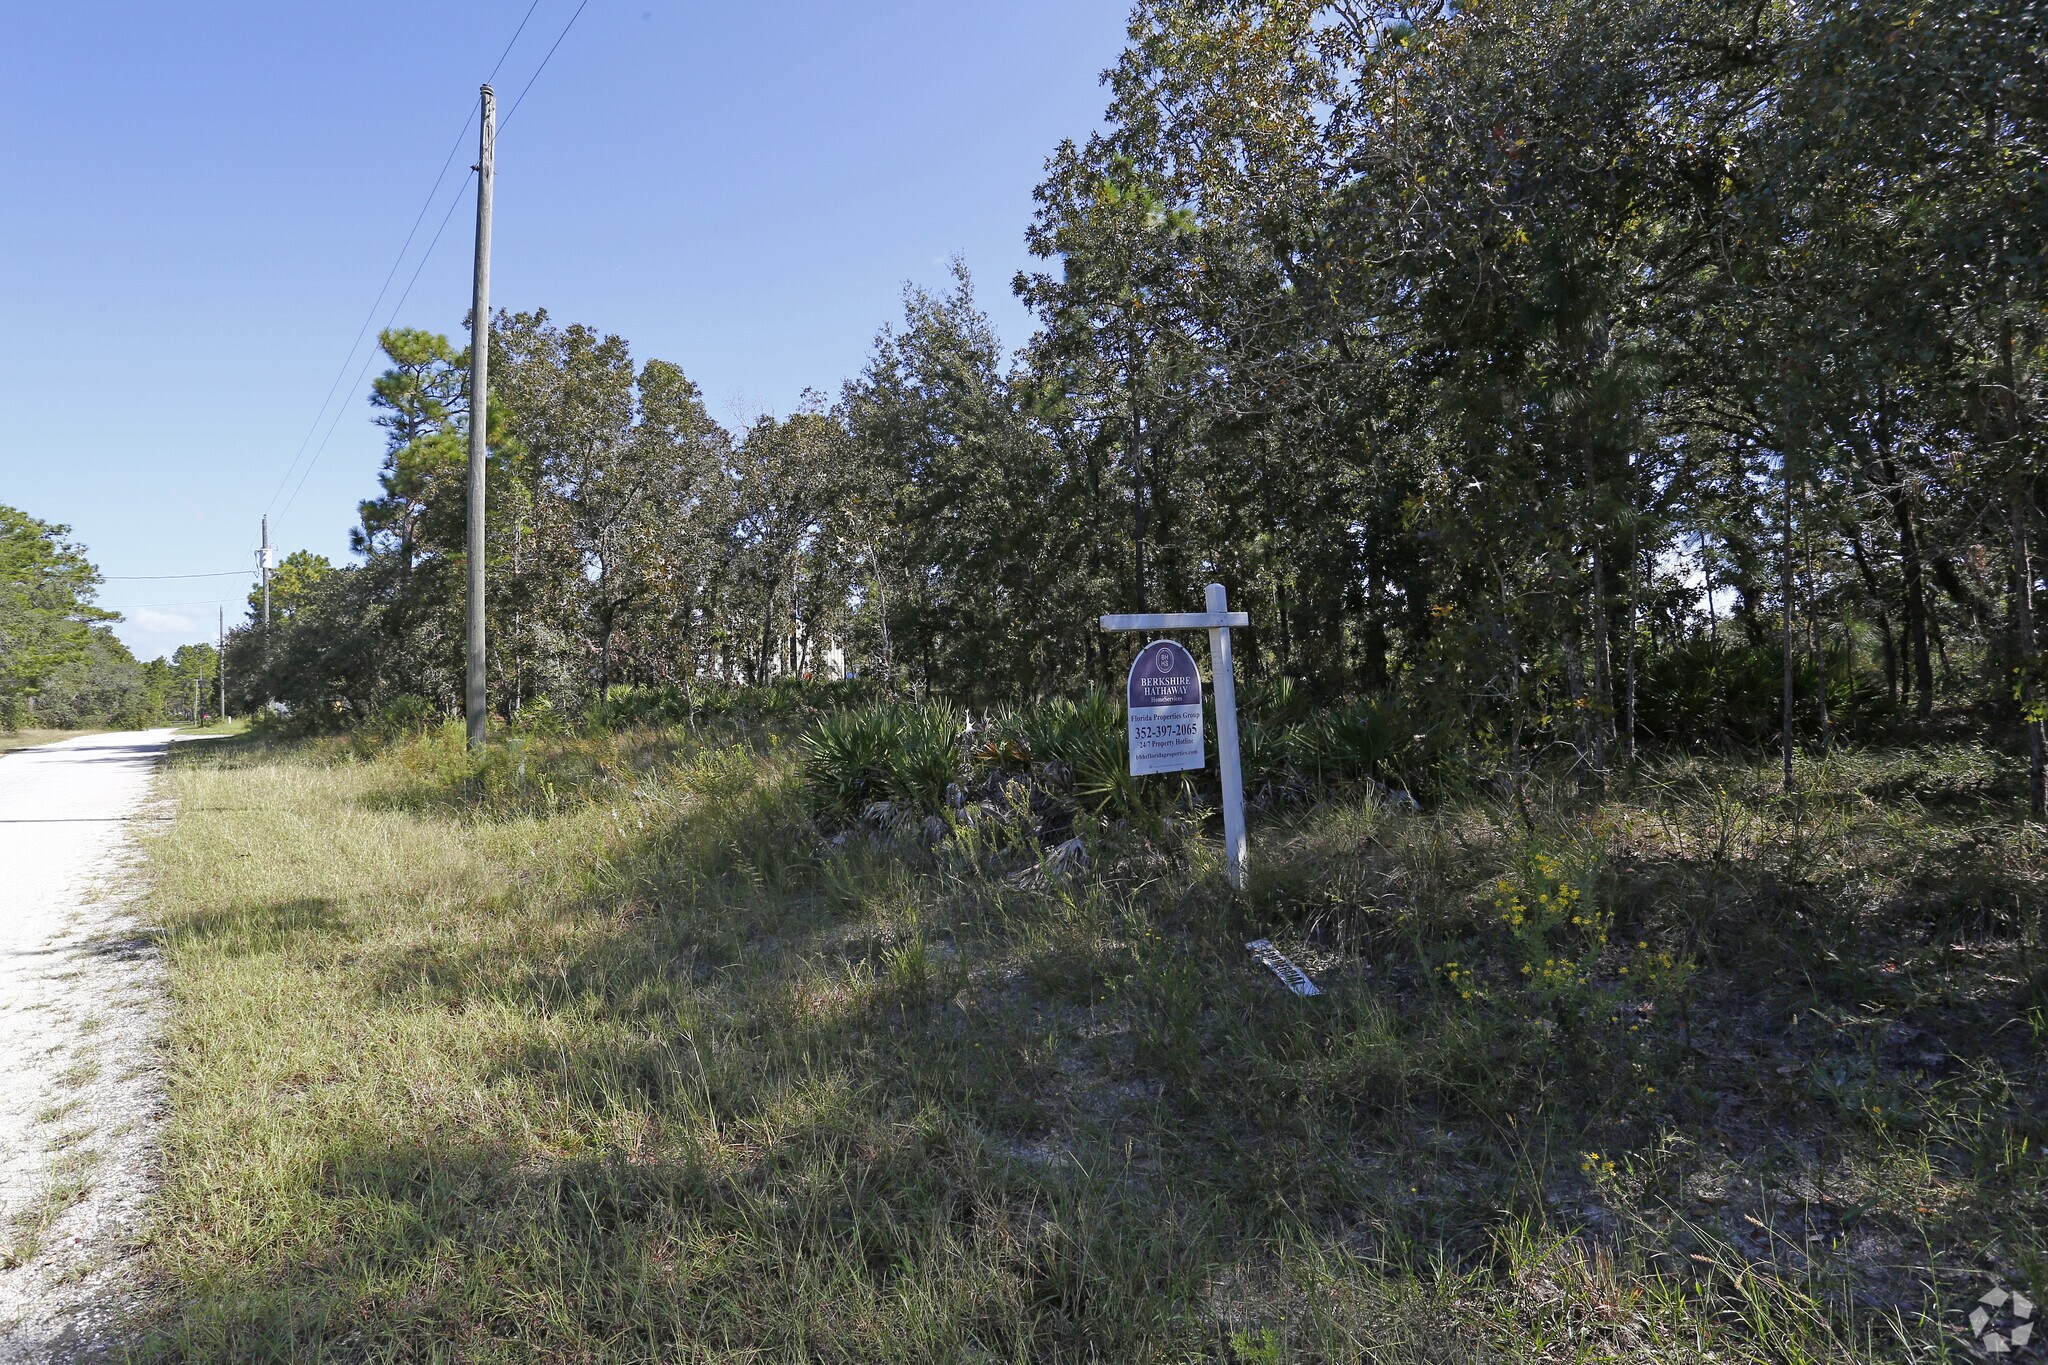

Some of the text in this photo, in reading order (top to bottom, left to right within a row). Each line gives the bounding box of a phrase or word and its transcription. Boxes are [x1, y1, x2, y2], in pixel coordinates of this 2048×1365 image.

[1141, 677, 1191, 686] BERKSHIRE
[1144, 686, 1188, 696] HATHAWAY
[1131, 712, 1200, 722] Florida Properties Group
[1135, 723, 1197, 739] 352-397-2065
[1139, 738, 1194, 748] 24/7 Property Hotline
